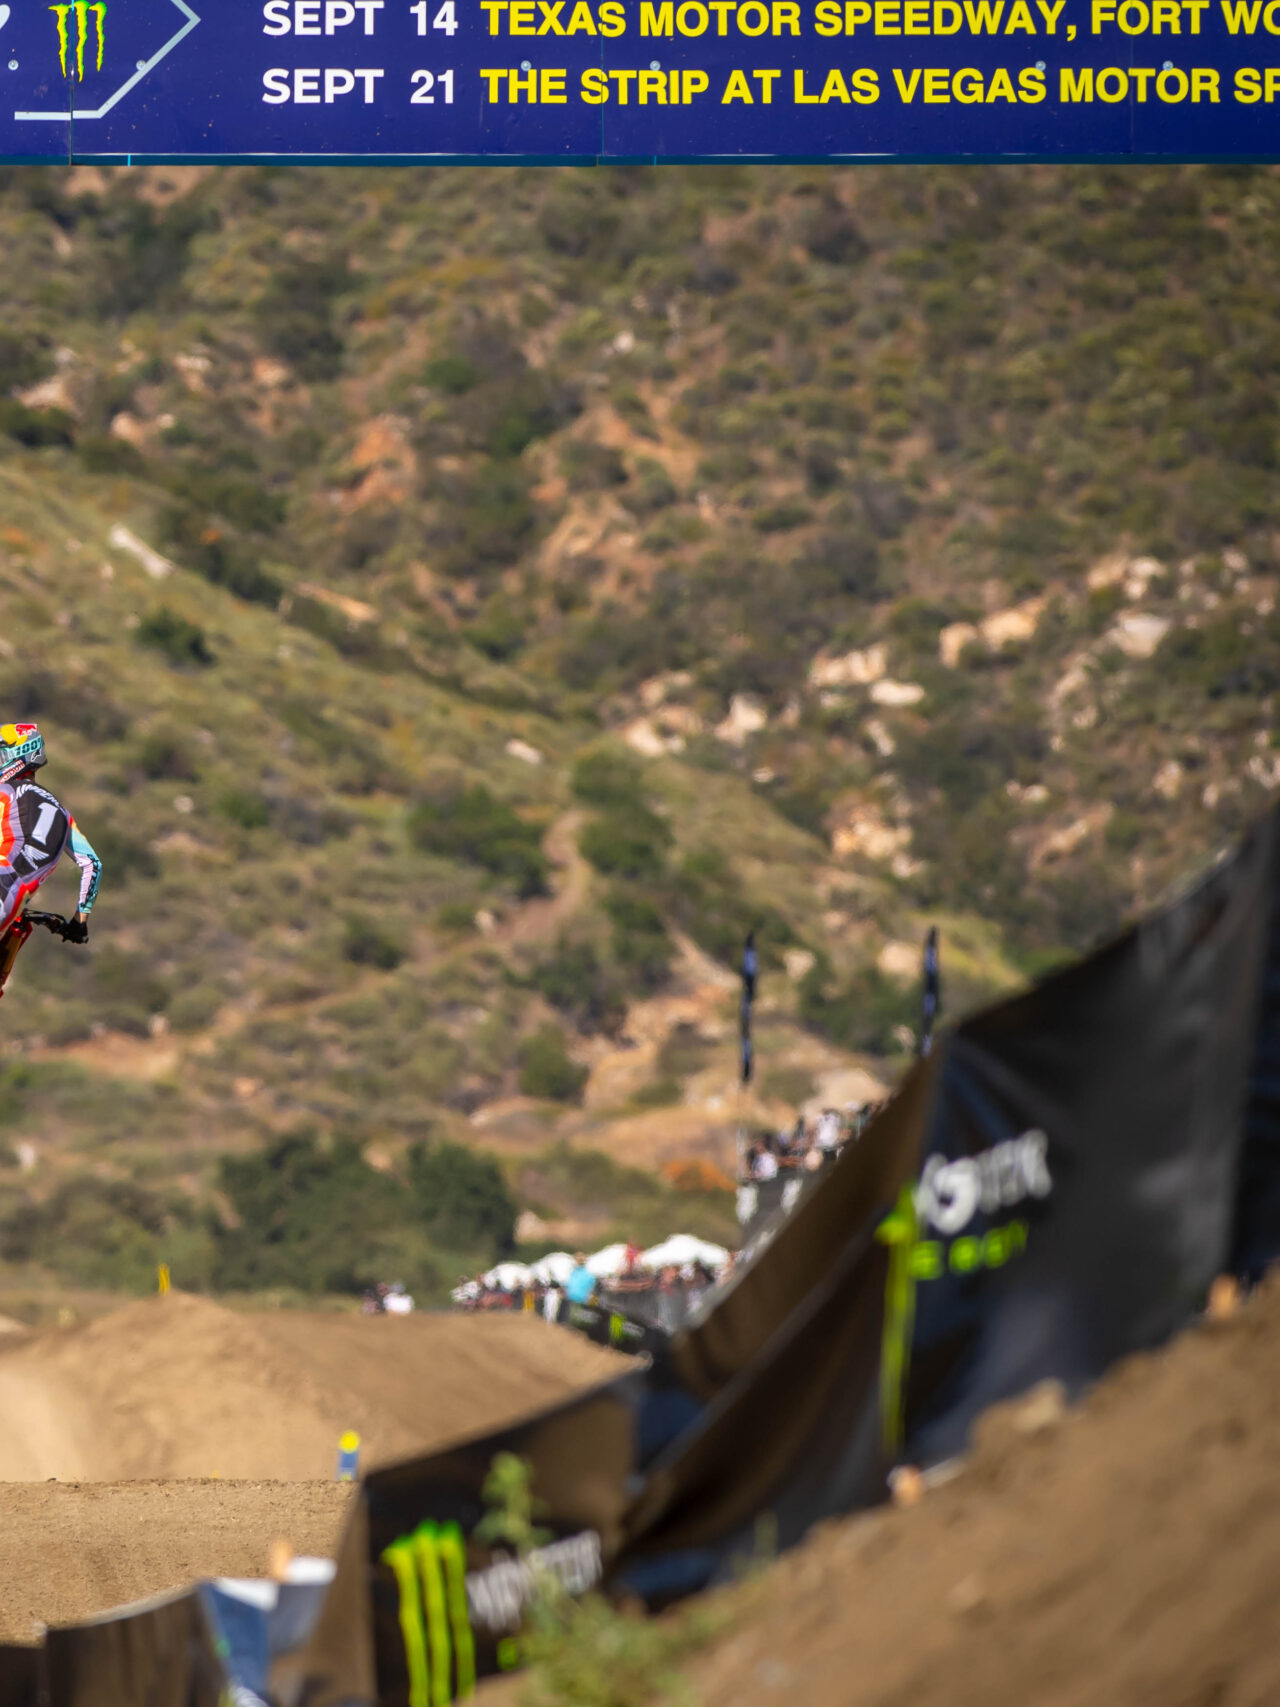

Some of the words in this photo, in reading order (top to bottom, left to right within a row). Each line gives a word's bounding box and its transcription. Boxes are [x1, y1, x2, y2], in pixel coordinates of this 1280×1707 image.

[263, 0, 384, 35] SEPT
[410, 1, 458, 36] 14
[480, 1, 626, 37] TEXAS
[640, 1, 801, 37] MOTOR
[815, 0, 1076, 41] SPEEDWAY,
[1091, 0, 1210, 35] FORT
[263, 69, 384, 104] SEPT
[411, 70, 454, 104] 21
[480, 69, 567, 104] THE
[581, 68, 709, 105] STRIP
[722, 70, 781, 104] AT
[794, 69, 880, 104] LAS
[893, 67, 1046, 103] VEGAS
[1060, 67, 1220, 103] MOTOR
[31, 802, 59, 846] 1
